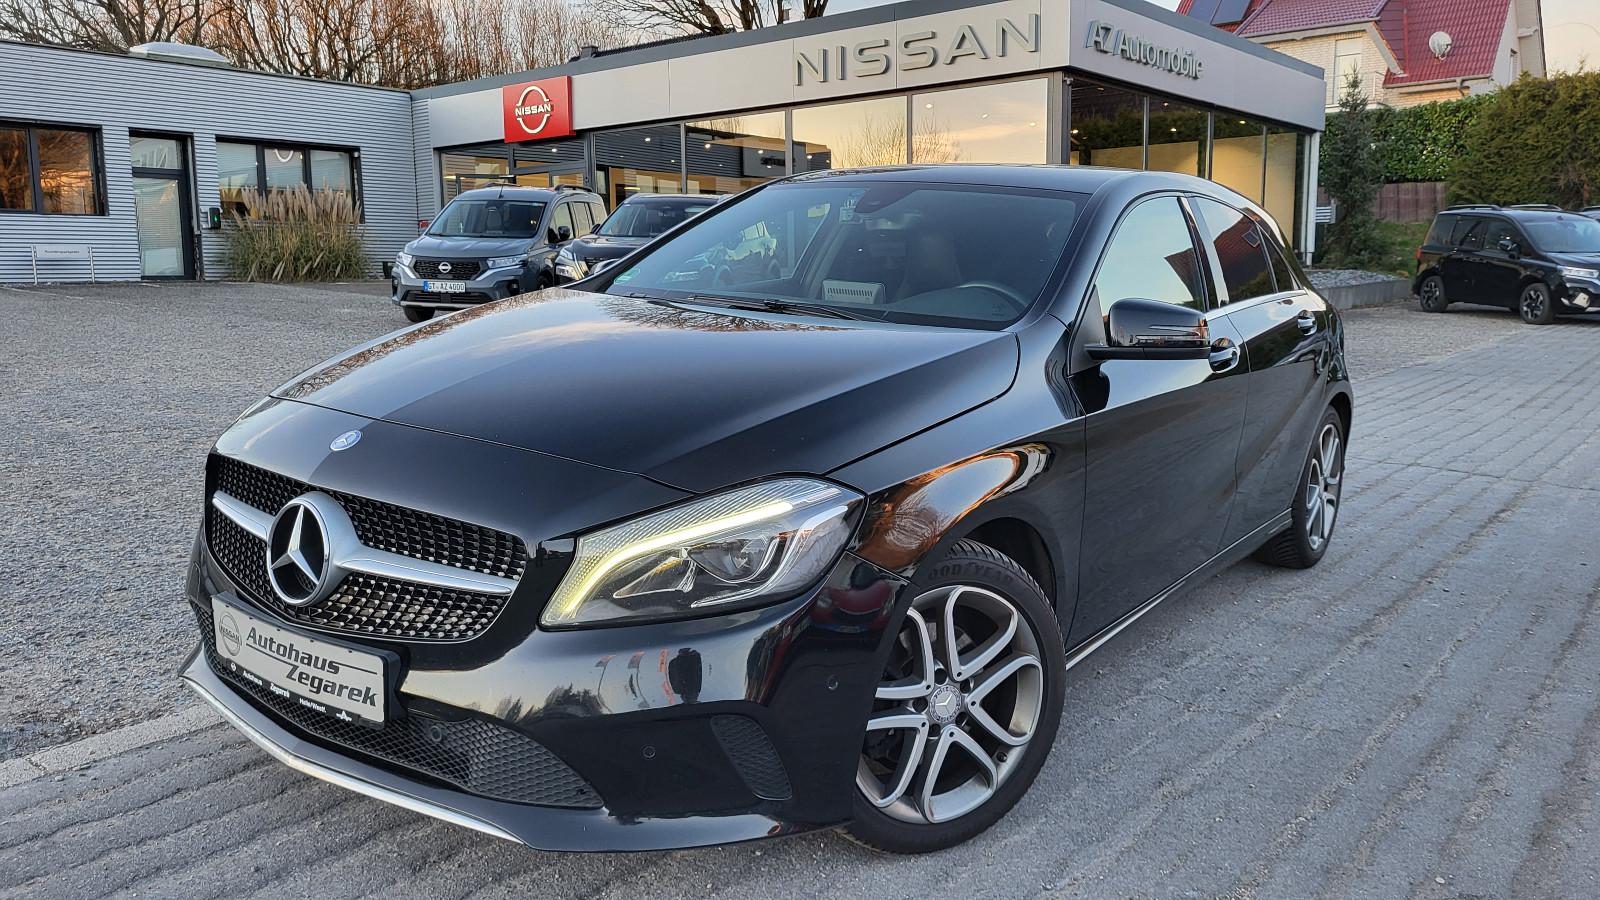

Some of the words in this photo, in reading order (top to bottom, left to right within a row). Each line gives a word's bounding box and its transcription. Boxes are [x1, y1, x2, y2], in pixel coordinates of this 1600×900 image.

[794, 13, 1038, 86] NISSAN
[515, 103, 551, 116] NISSAN
[246, 626, 340, 675] Autohaus
[286, 665, 379, 707] Zegarek
